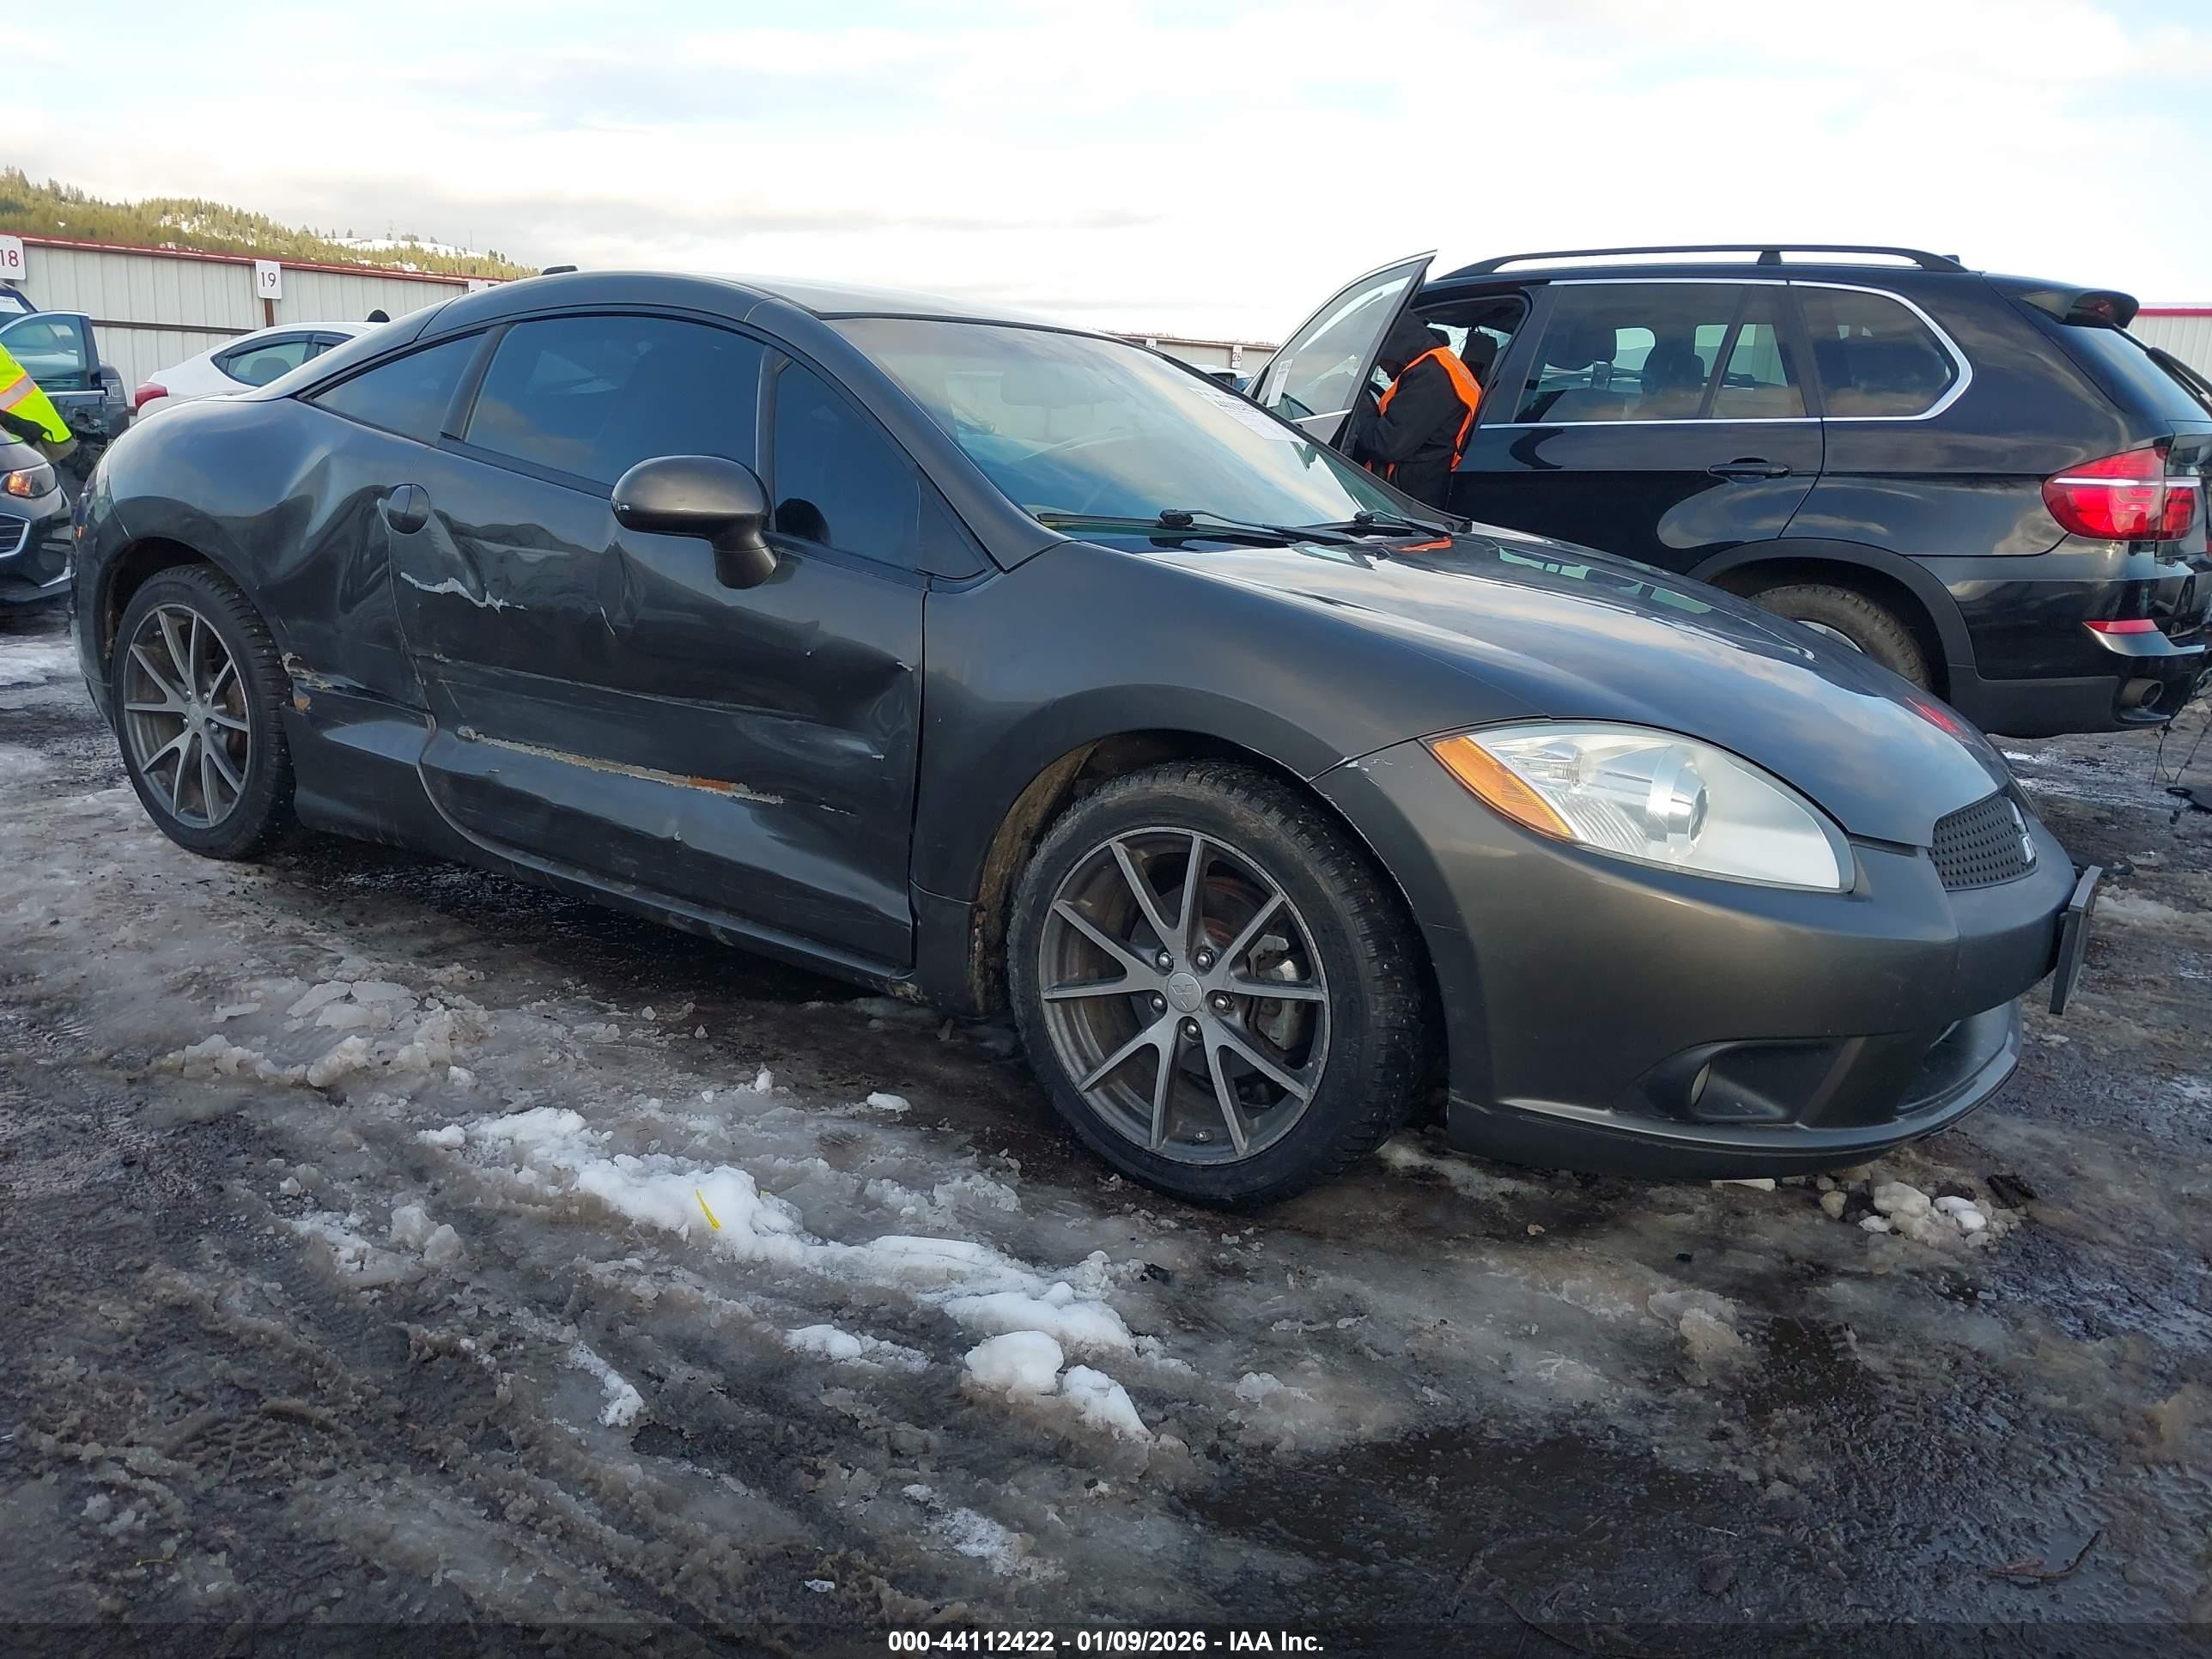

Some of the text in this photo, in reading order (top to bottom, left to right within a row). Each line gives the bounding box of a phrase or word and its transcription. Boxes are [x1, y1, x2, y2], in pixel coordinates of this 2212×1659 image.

[0, 249, 18, 267] 18
[261, 271, 276, 288] 19
[1232, 351, 1242, 362] 26
